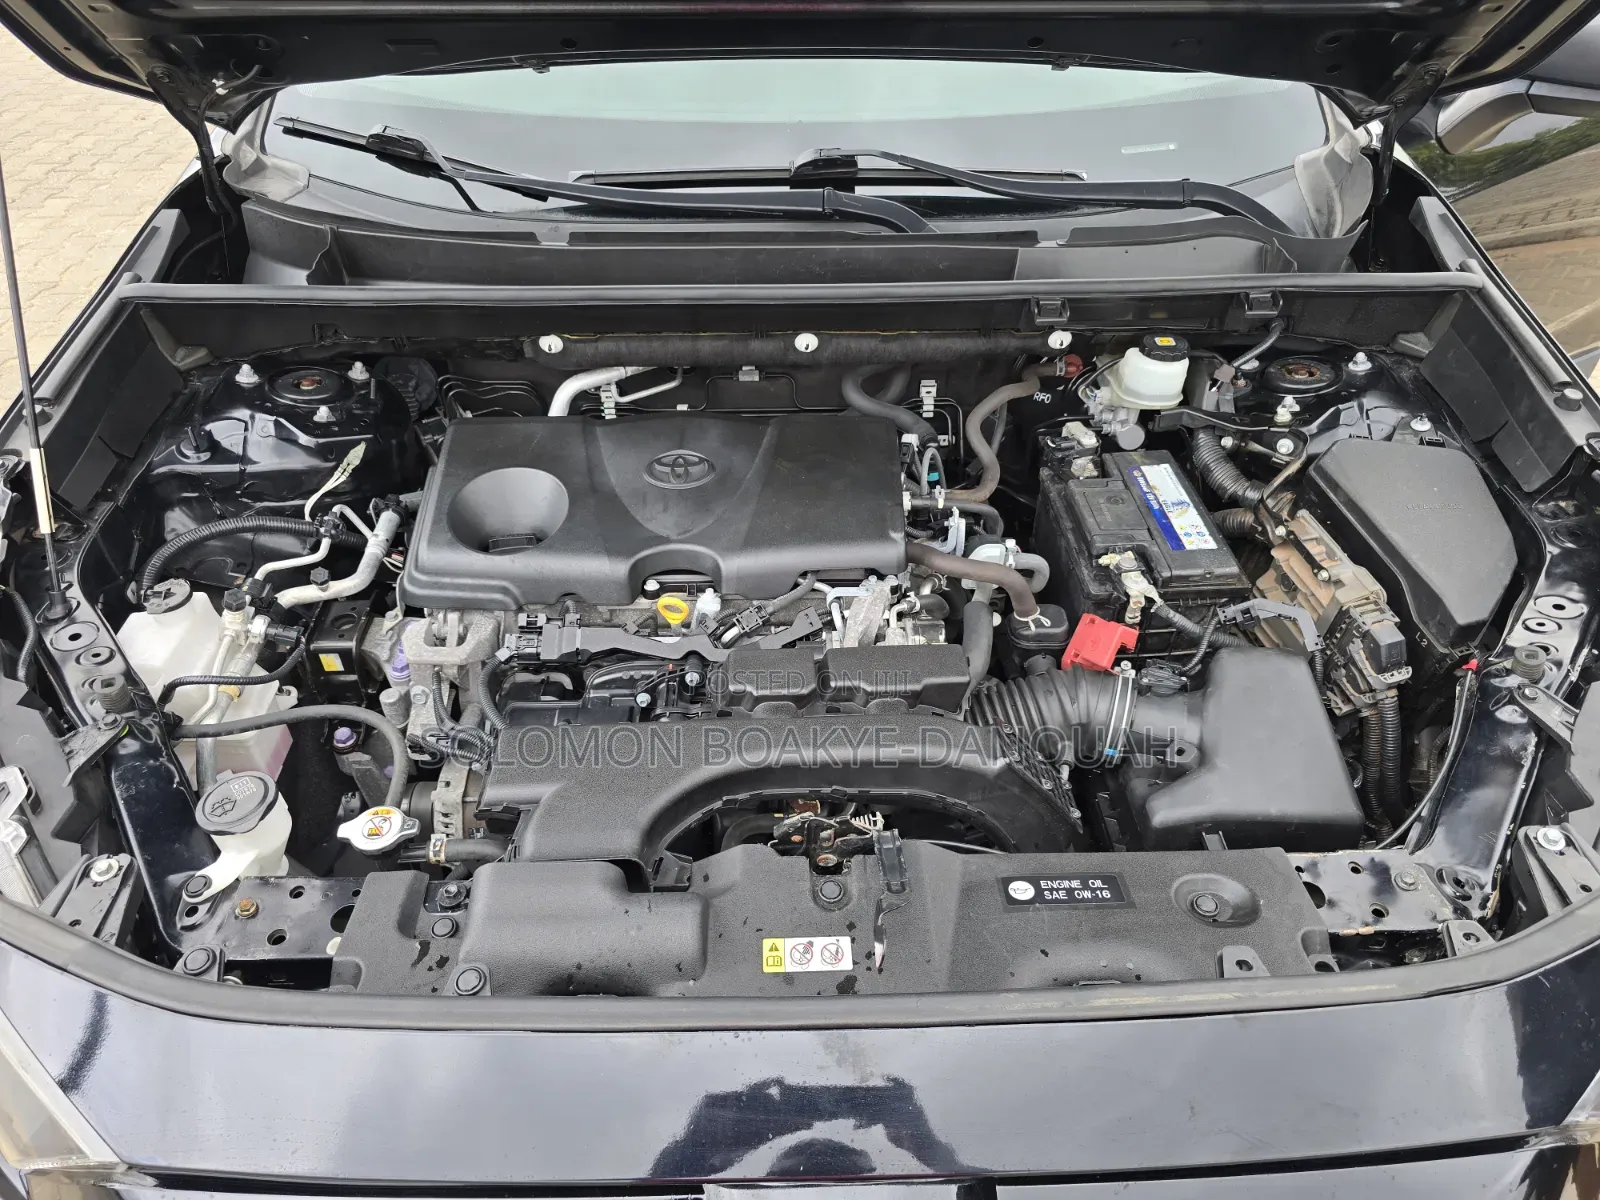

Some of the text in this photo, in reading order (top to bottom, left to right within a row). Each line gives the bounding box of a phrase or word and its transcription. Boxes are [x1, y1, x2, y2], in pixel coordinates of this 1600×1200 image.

[1040, 879, 1108, 889] ENGINE OIL
[1044, 889, 1111, 900] SAE 0W-16
